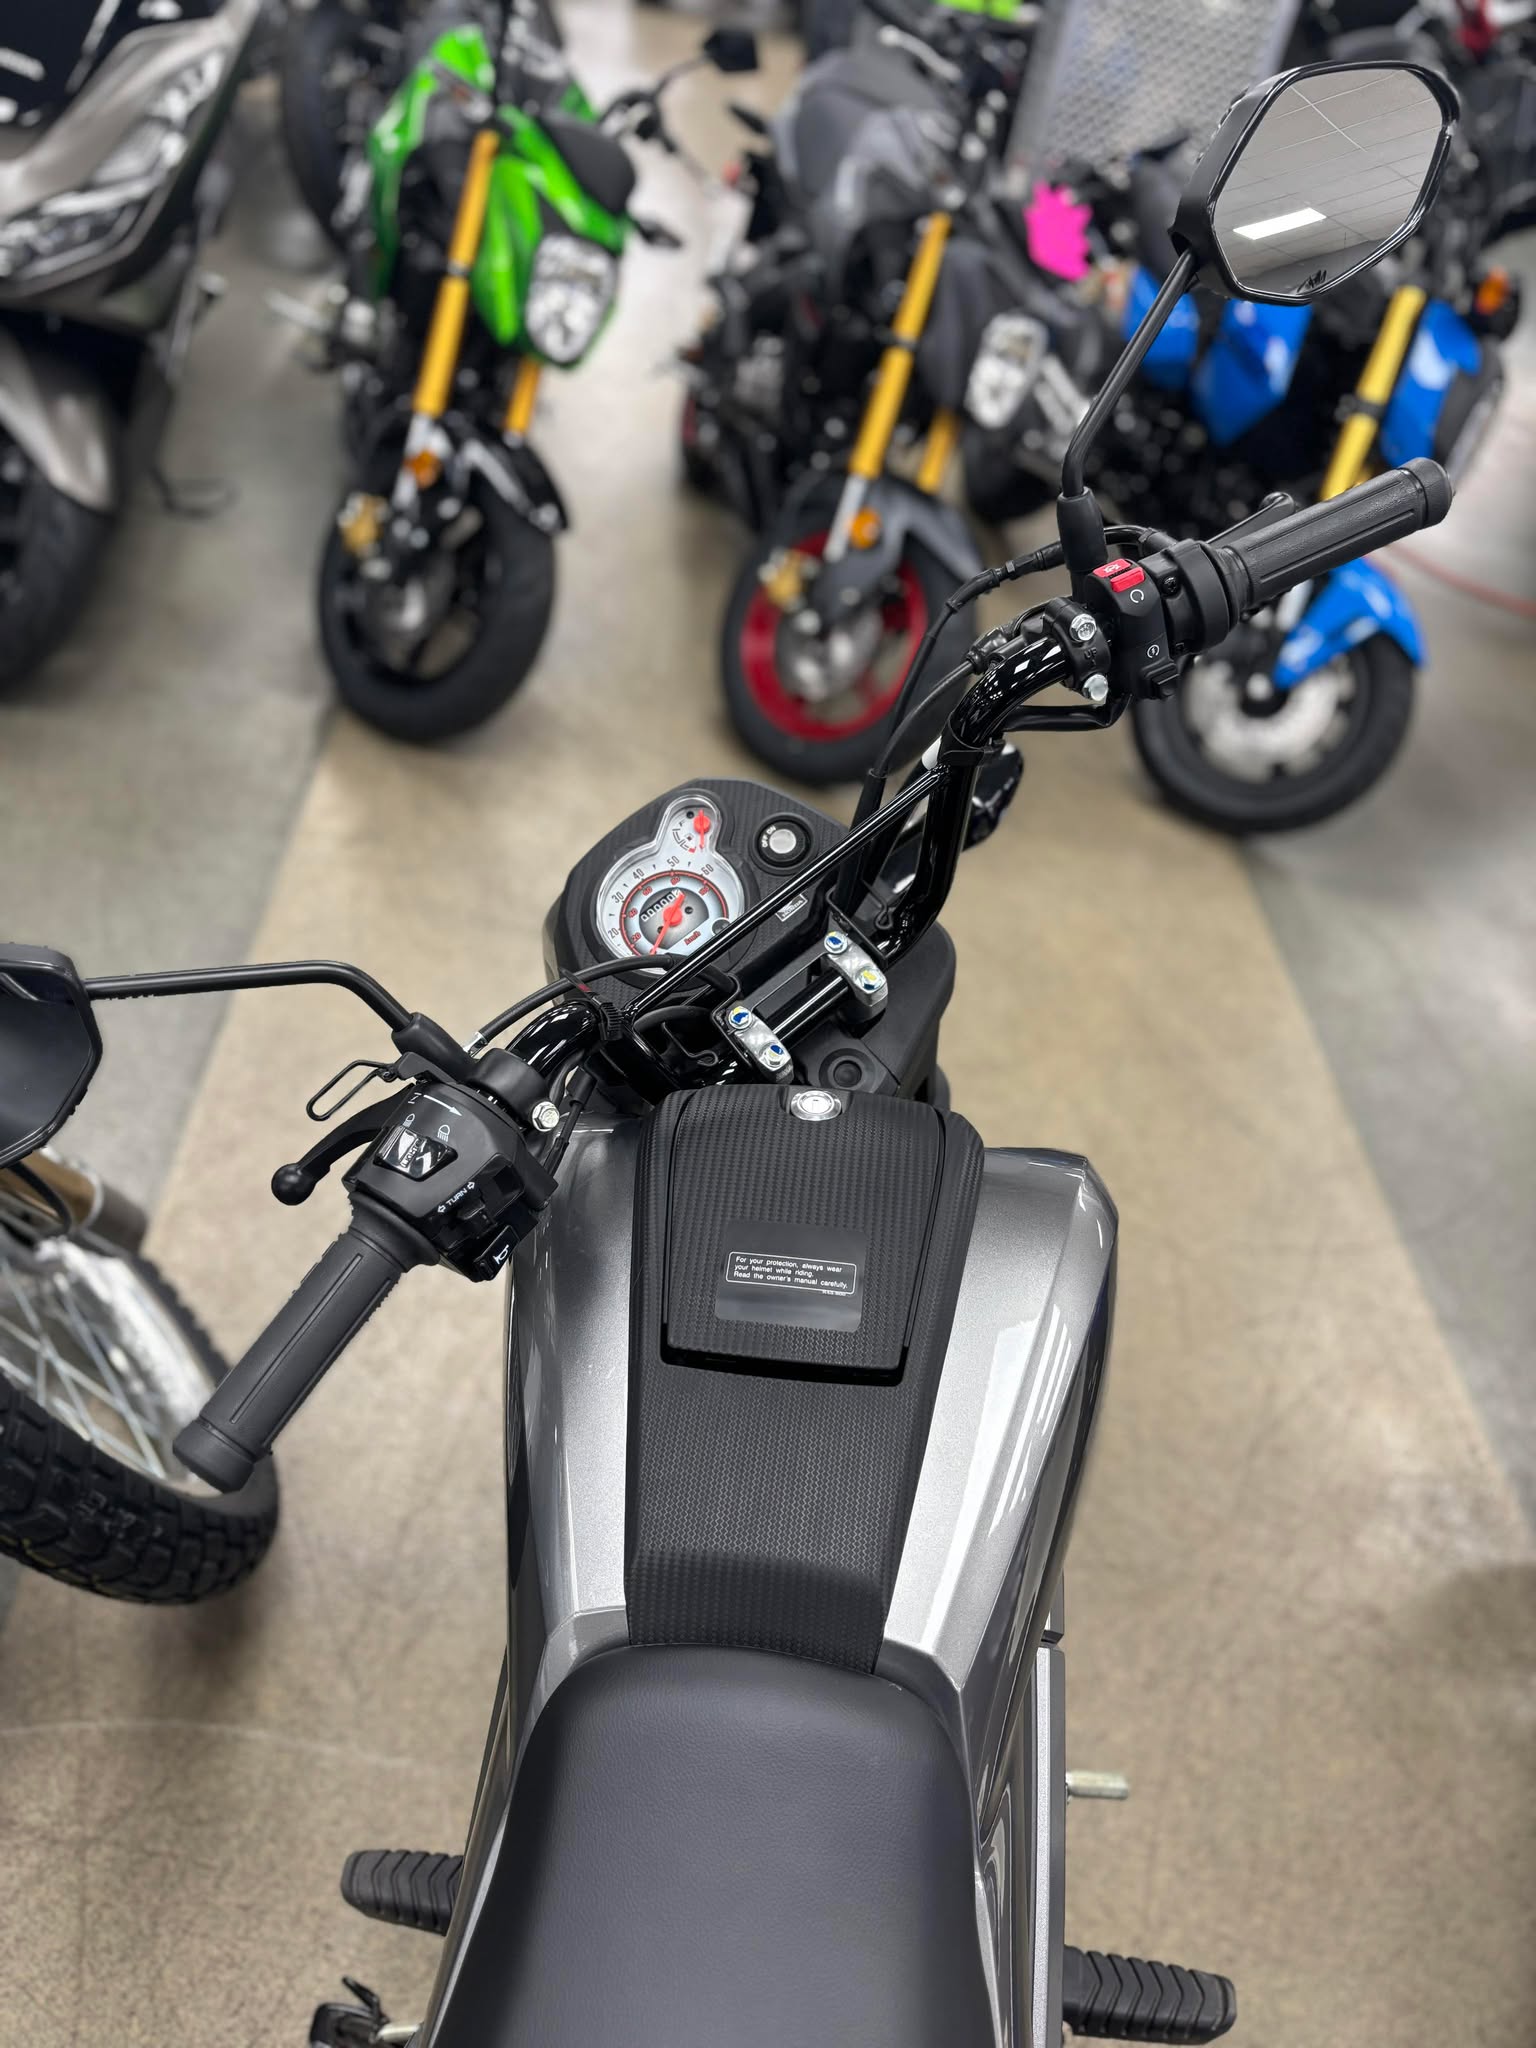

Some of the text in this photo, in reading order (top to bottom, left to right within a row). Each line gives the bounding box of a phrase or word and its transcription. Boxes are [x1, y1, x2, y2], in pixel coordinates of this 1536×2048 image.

[667, 856, 680, 867] 50
[633, 868, 644, 879] 40
[701, 864, 714, 875] 60
[612, 892, 624, 903] 30
[608, 927, 619, 939] 20
[446, 1188, 467, 1205] TURN
[766, 1260, 798, 1268] protection,
[802, 1263, 824, 1271] always
[795, 1270, 814, 1278] riding.
[820, 1280, 848, 1289] carefully.
